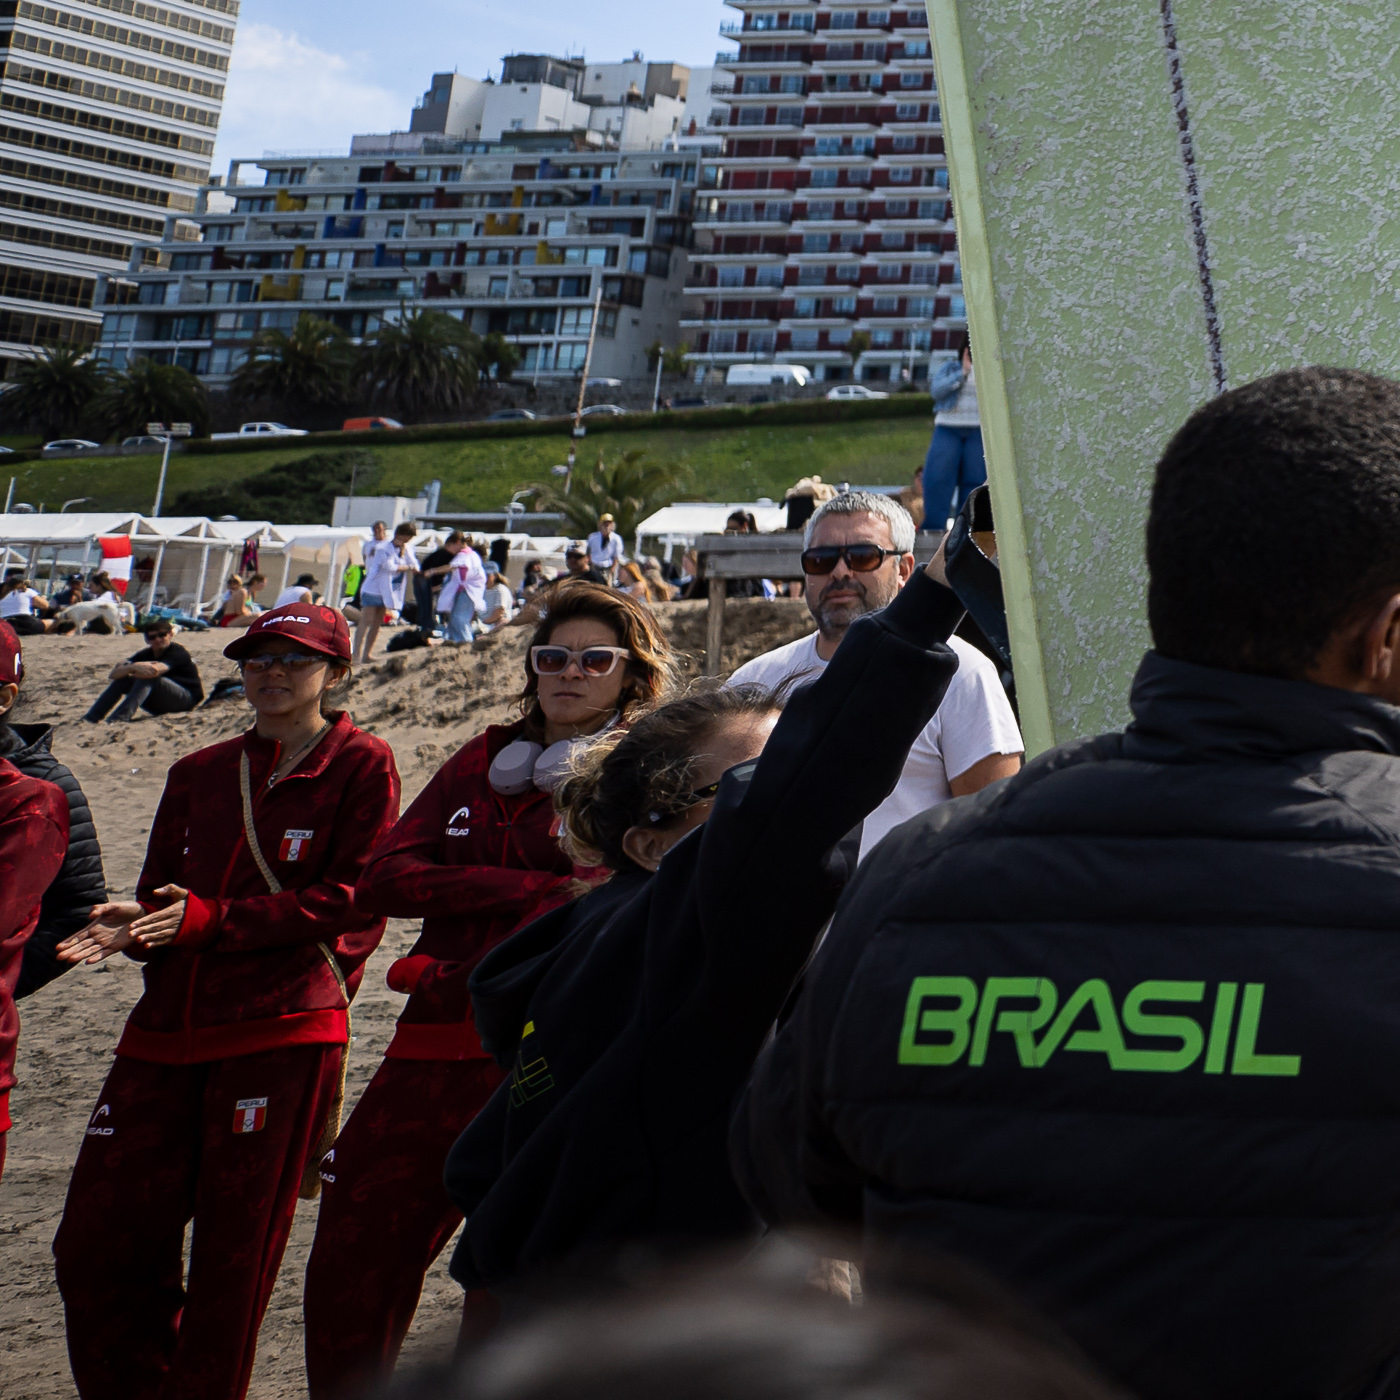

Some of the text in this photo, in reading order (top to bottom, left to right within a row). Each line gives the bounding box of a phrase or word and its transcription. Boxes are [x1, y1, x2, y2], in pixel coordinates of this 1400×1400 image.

[262, 615, 310, 628] HEAD
[897, 975, 1302, 1076] BRASIL
[237, 1100, 266, 1108] PERU
[87, 1127, 115, 1136] EAD
